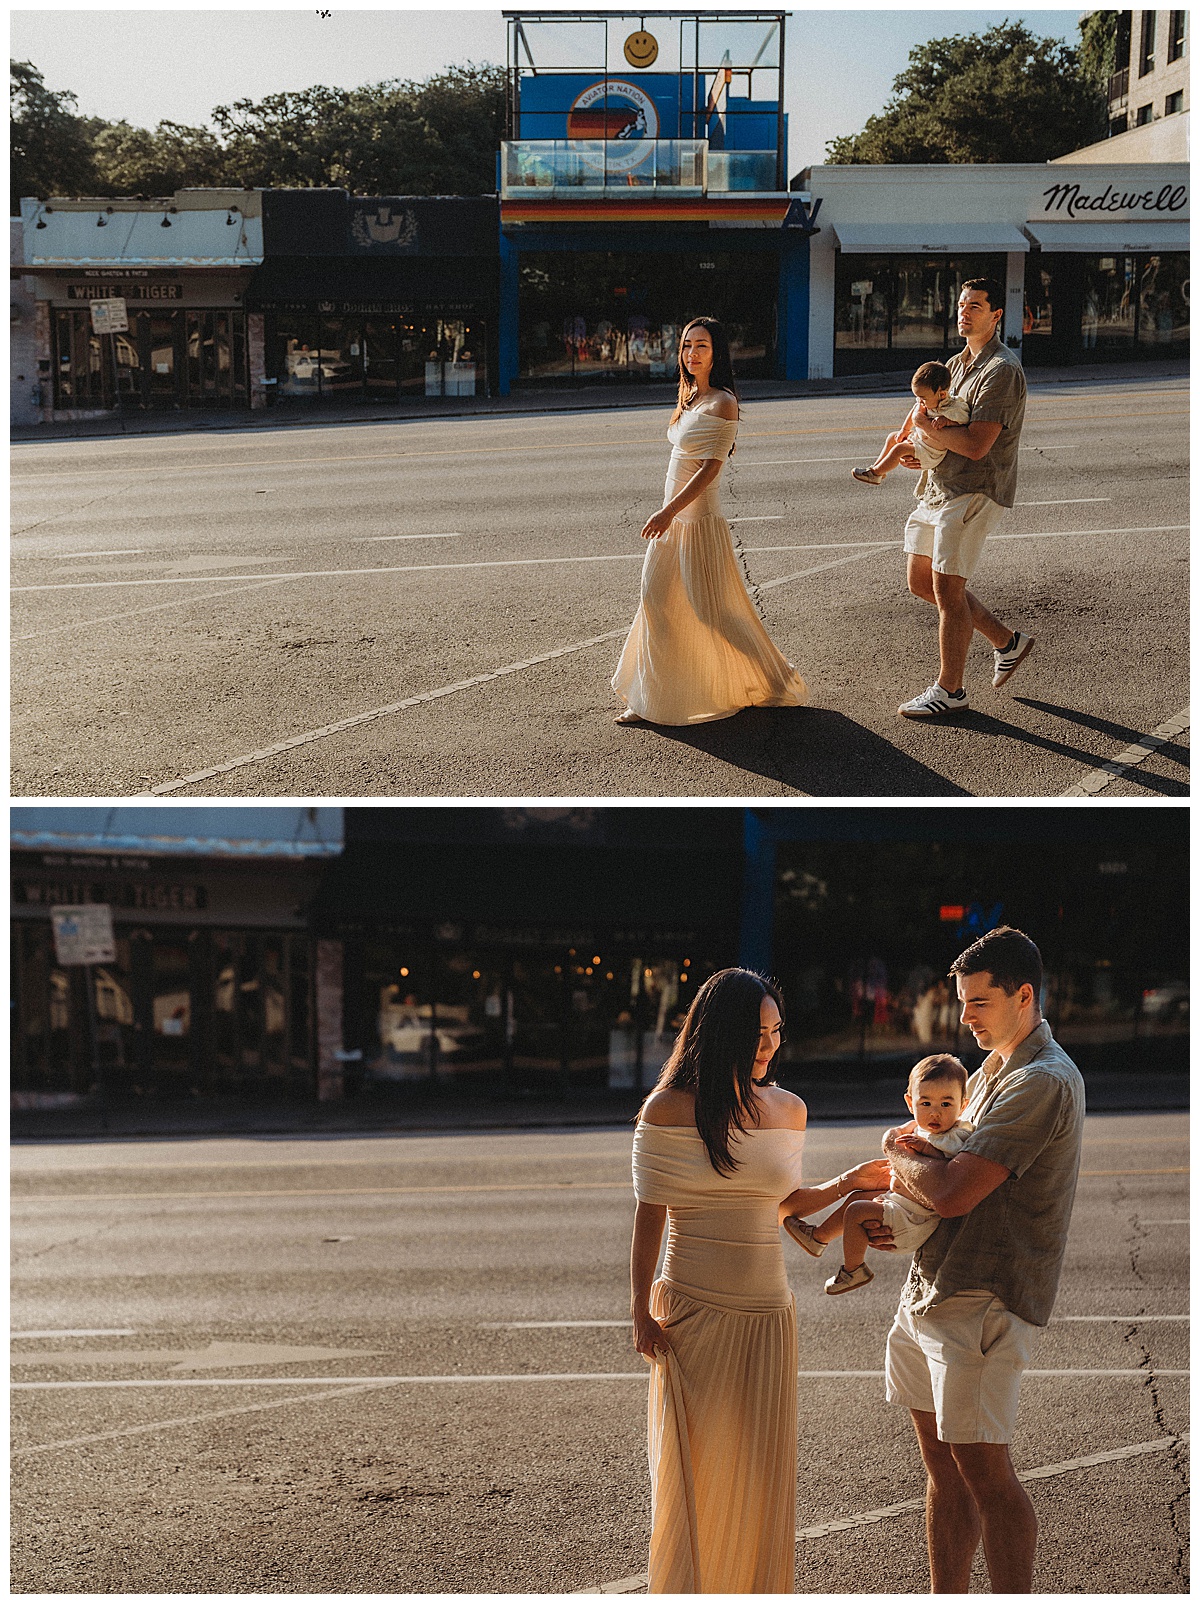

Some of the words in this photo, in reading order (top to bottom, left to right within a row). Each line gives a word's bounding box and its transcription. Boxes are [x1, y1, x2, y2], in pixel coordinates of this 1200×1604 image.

[582, 85, 614, 106] AVIATOR
[616, 85, 646, 105] NATION
[1043, 184, 1188, 218] Madewell
[699, 262, 716, 270] 1325
[74, 285, 116, 299] WHITE
[139, 285, 177, 299] TIGER
